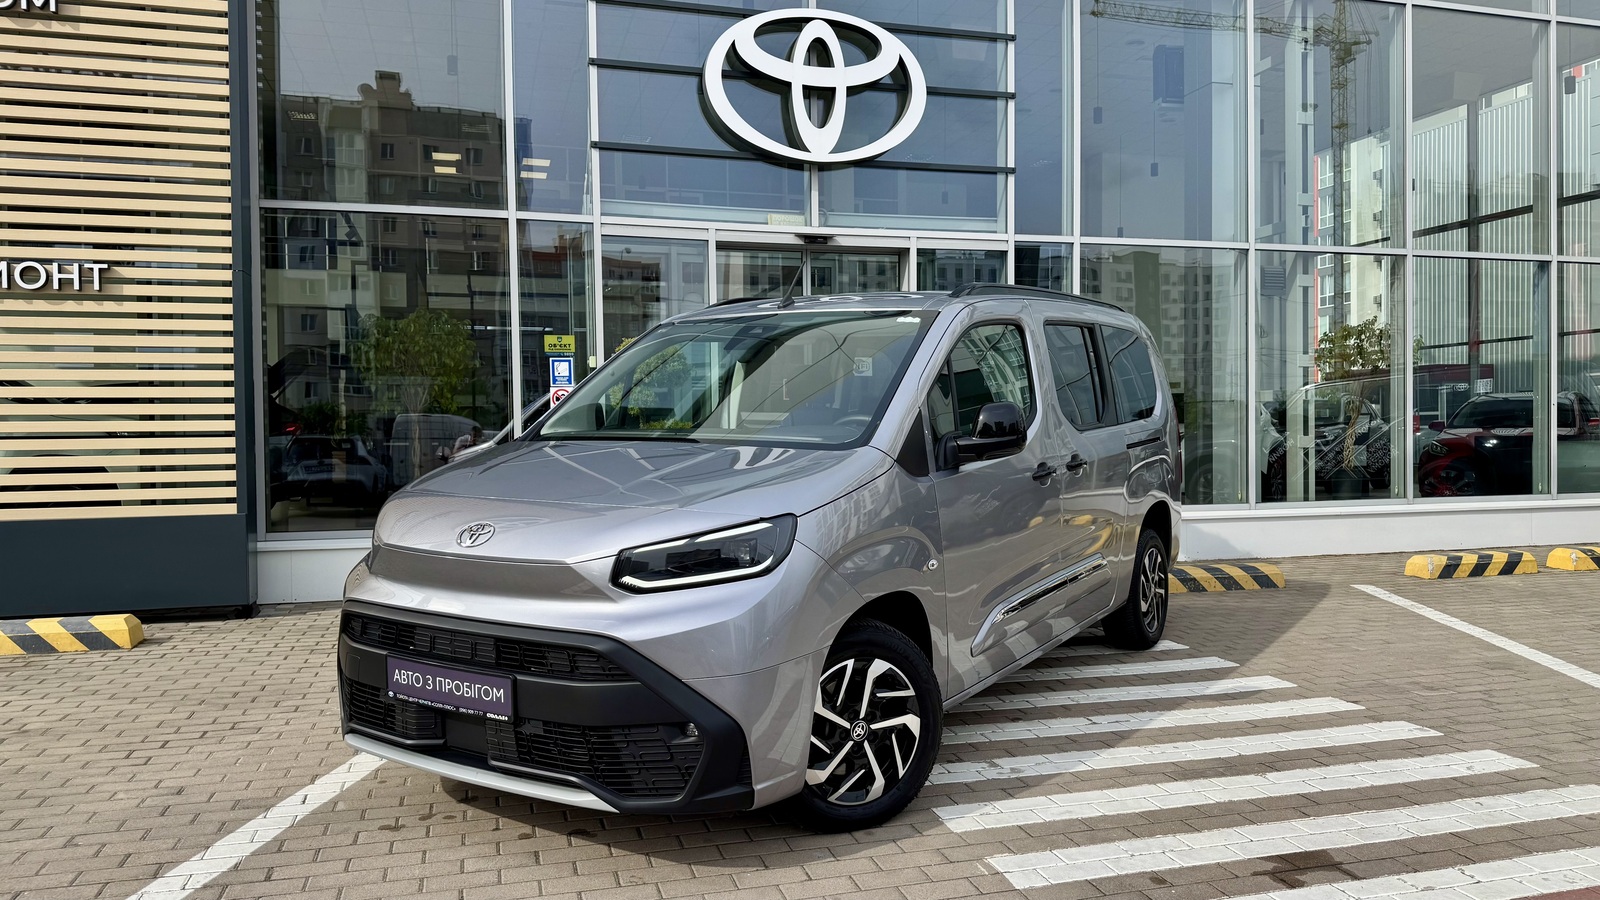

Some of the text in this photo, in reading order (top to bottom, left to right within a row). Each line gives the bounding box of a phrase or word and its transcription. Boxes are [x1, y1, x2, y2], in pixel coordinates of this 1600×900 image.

[0, 261, 109, 291] ОНТ
[393, 668, 423, 688] АВТО
[436, 677, 505, 704] ПРОБІГОМ
